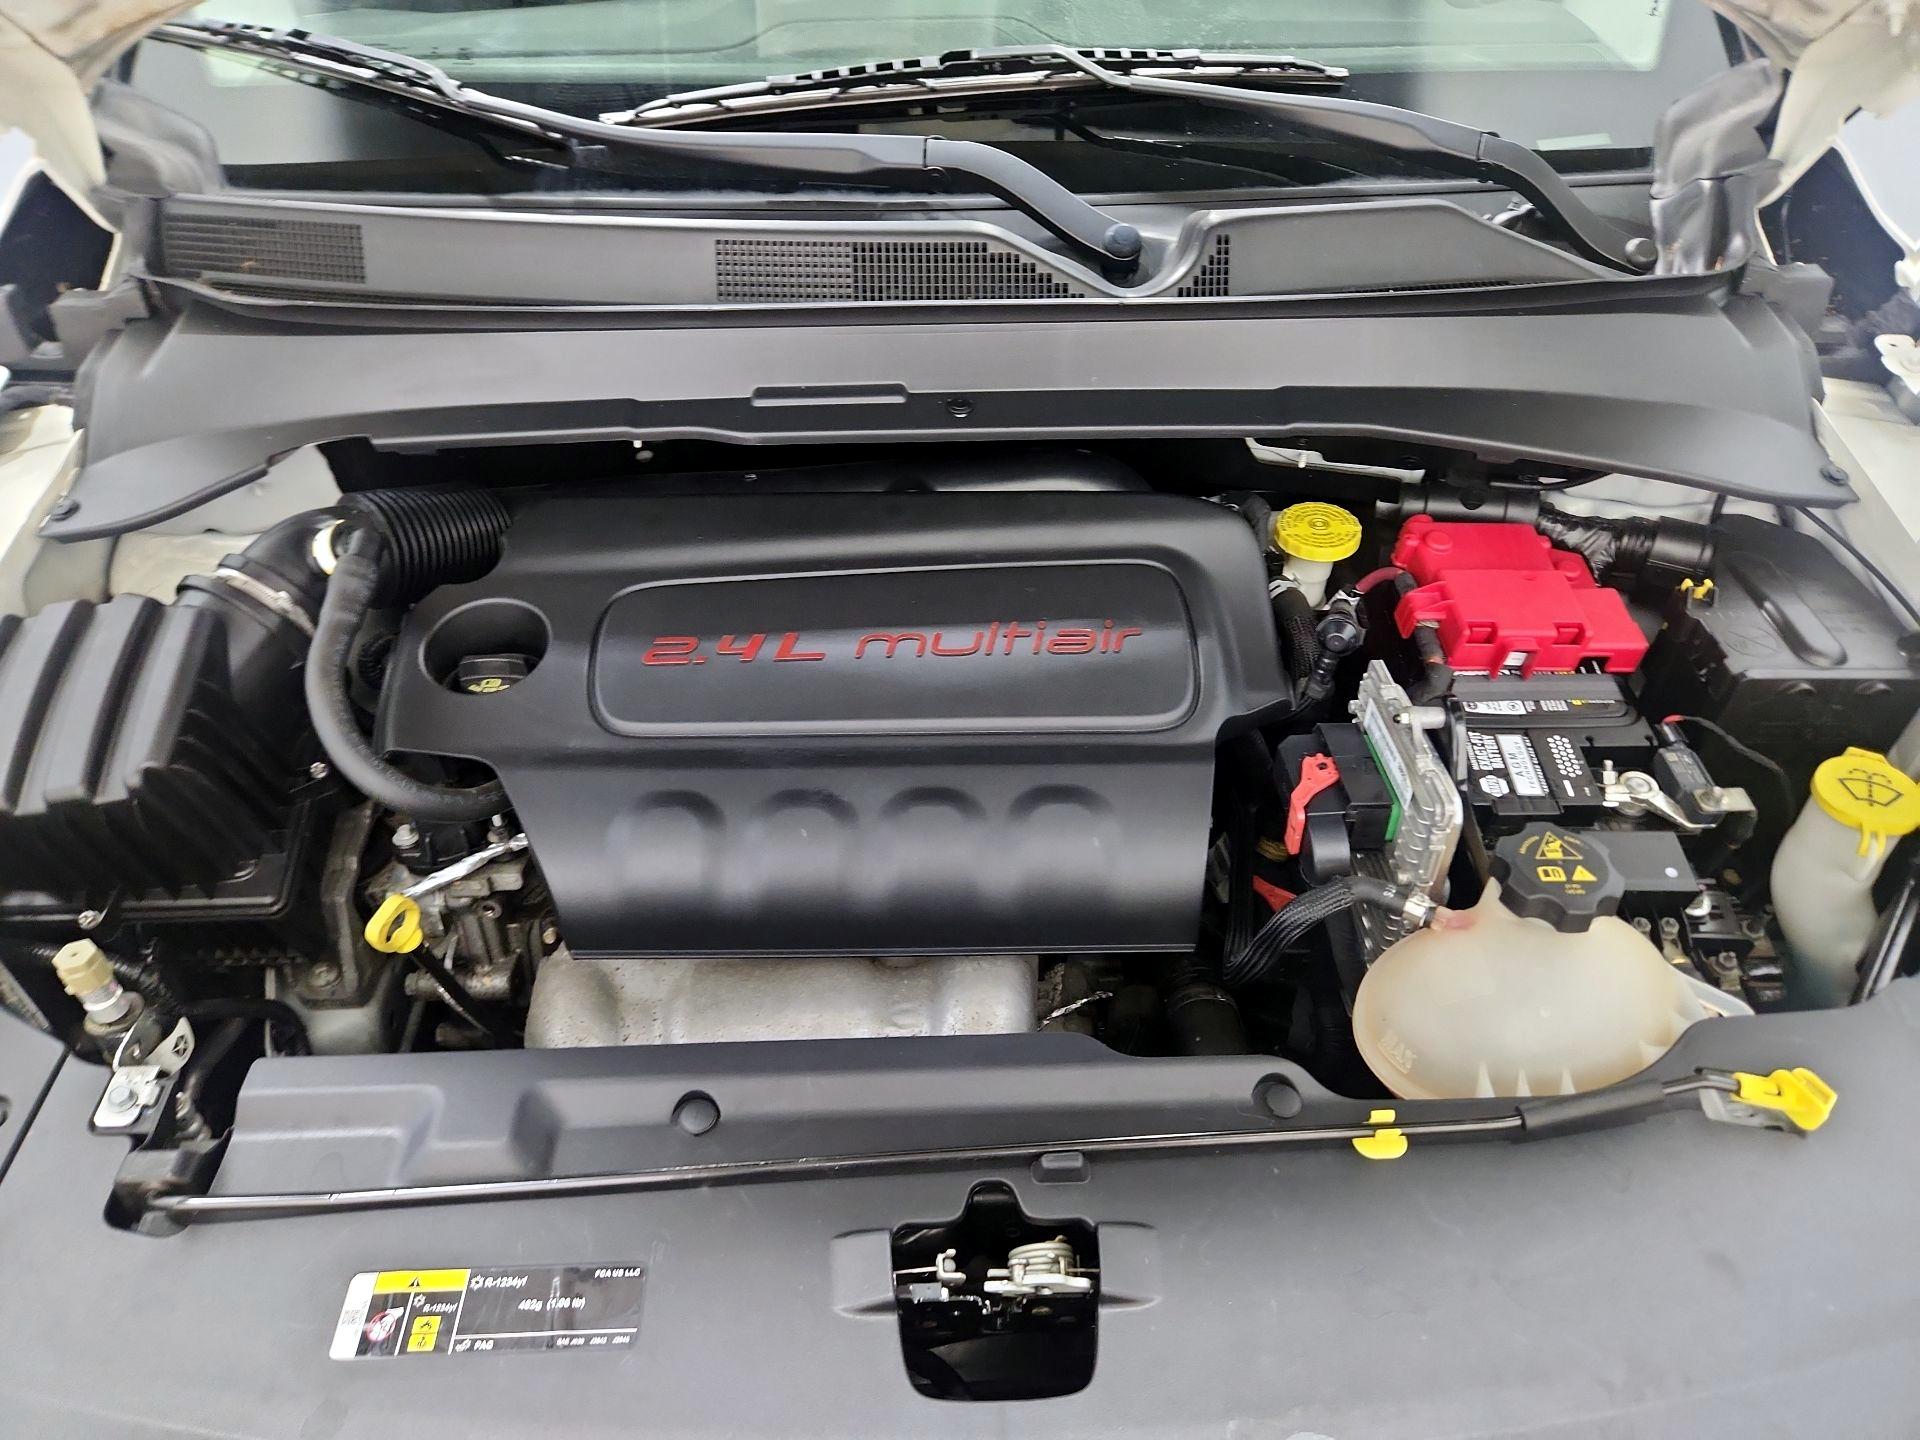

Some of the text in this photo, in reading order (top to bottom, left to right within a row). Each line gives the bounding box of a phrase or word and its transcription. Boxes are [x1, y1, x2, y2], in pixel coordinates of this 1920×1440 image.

[641, 618, 1143, 665] 2.4L multiair
[1480, 734, 1506, 769] BATTERY
[1508, 751, 1525, 778] AGM
